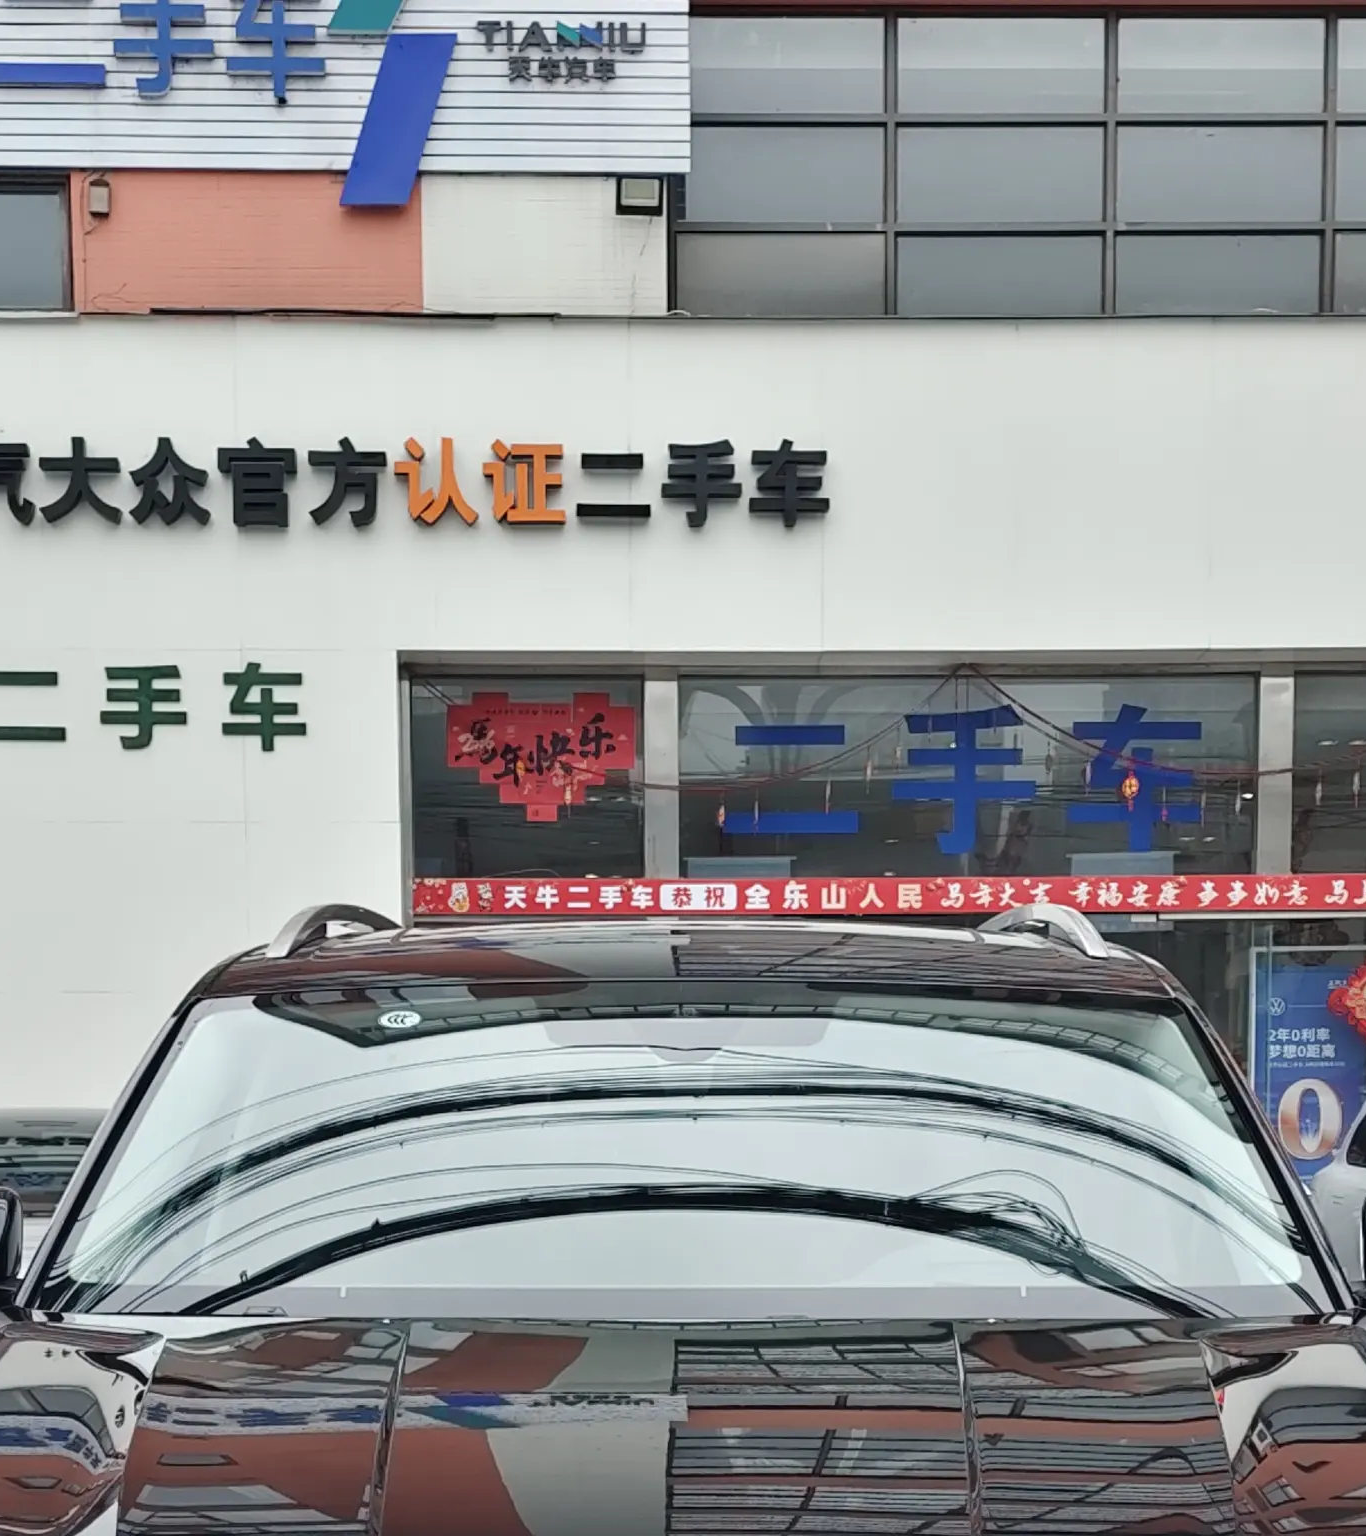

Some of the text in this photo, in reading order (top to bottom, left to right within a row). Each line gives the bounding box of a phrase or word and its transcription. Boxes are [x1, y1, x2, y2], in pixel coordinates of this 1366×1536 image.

[720, 702, 1201, 856] 二手车
[504, 885, 655, 910] 天牛二手车
[672, 886, 726, 909] 恭祝
